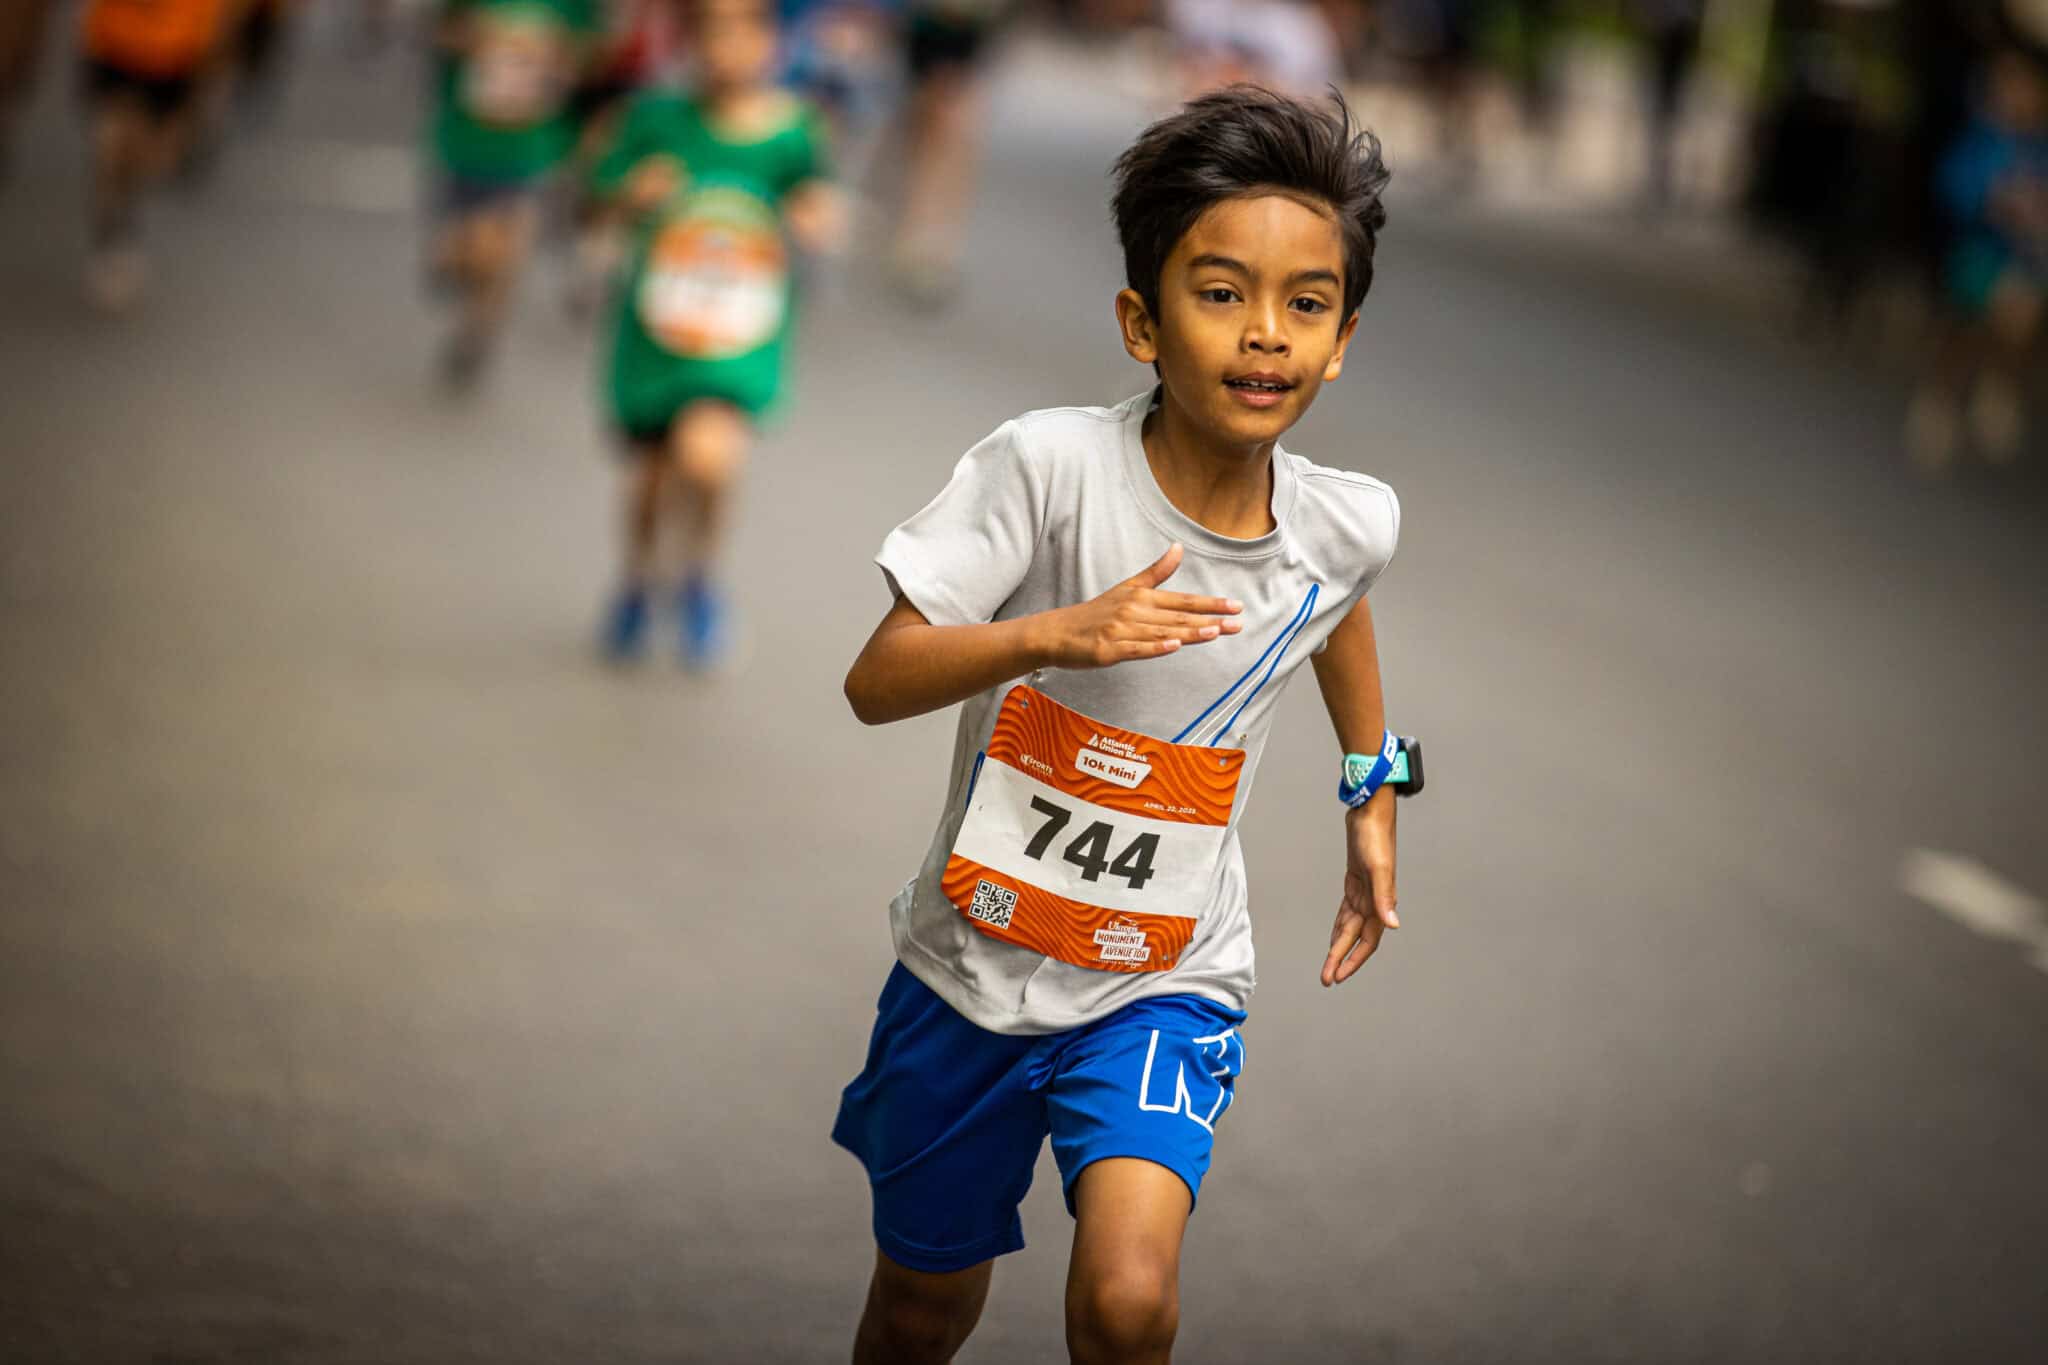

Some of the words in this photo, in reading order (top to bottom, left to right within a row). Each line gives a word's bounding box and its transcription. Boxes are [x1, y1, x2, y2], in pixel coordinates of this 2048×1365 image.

[1099, 742, 1124, 757] Union
[1125, 751, 1148, 763] Bank
[1101, 737, 1136, 752] Atlantic
[1029, 758, 1053, 775] SPORTS
[1083, 756, 1105, 772] 10k
[1108, 765, 1136, 781] Mini
[1144, 801, 1165, 811] APRIL
[1023, 794, 1160, 890] 744
[1096, 931, 1141, 945] MONUMENT
[1103, 946, 1133, 958] AVENUE
